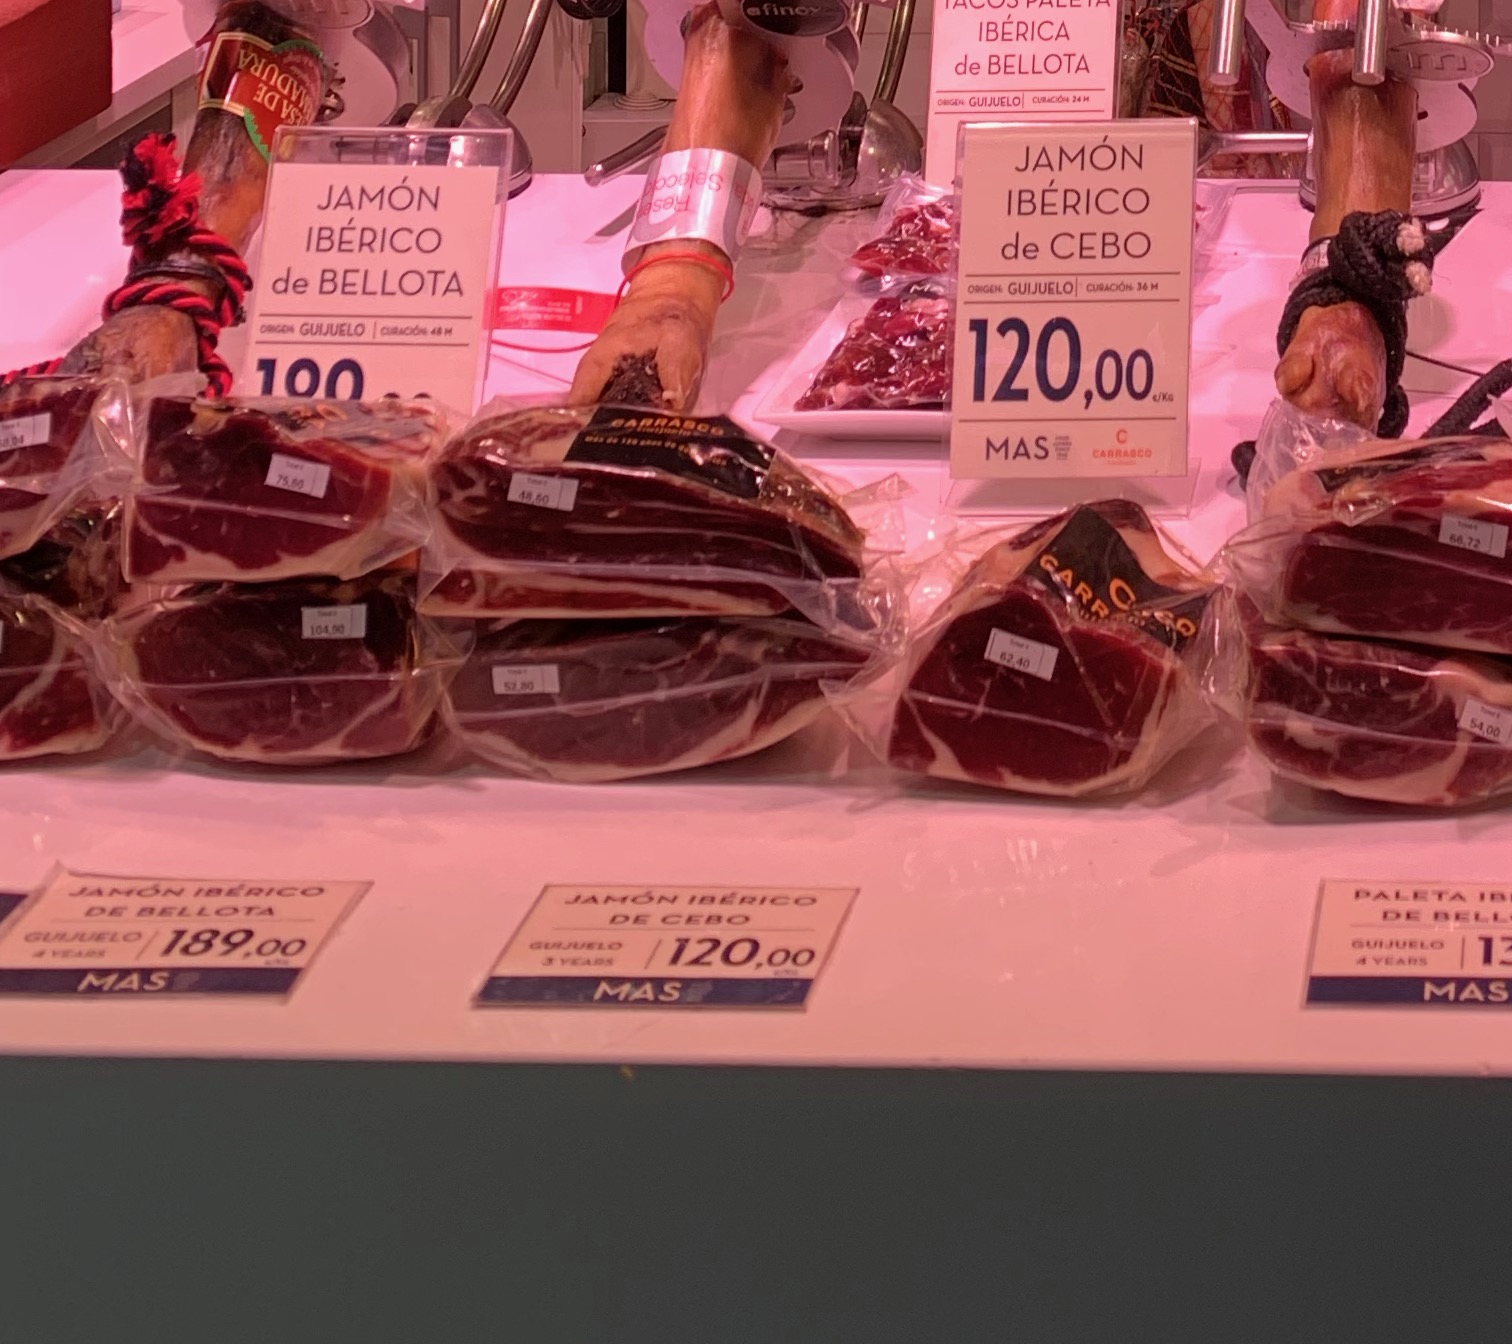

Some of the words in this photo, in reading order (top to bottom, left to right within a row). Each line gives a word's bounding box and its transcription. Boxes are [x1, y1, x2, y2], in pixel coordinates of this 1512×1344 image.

[978, 14, 1070, 42] IBÉRICA
[953, 55, 981, 76] de
[987, 53, 1091, 75] BELLOTA
[967, 95, 1022, 108] GUIJUELO
[1015, 136, 1143, 172] JAMÓN
[317, 177, 439, 211] JAMÓN
[1008, 180, 1150, 216] IBÉRICO
[306, 220, 441, 254] IBÉRICO
[1001, 232, 1038, 261] de
[1050, 232, 1151, 258] CEBO
[272, 269, 308, 295] de
[319, 269, 464, 298] BELLOTA
[1007, 280, 1074, 297] GUIJUELO
[968, 317, 1154, 409] 120,00
[985, 435, 1050, 461] MAS
[68, 883, 184, 898] JAMÓN
[193, 882, 326, 898] IBÉRICO
[563, 890, 679, 906] JAMÓN
[687, 891, 818, 907] IBÉRICO
[1354, 888, 1468, 904] PALETA
[136, 905, 276, 918] BELLOTA
[659, 913, 752, 926] CEBO
[160, 929, 306, 958] 189,00
[667, 938, 815, 969] 120,00
[1351, 938, 1445, 951] GUIJUELO
[1422, 981, 1509, 1003] MAS
